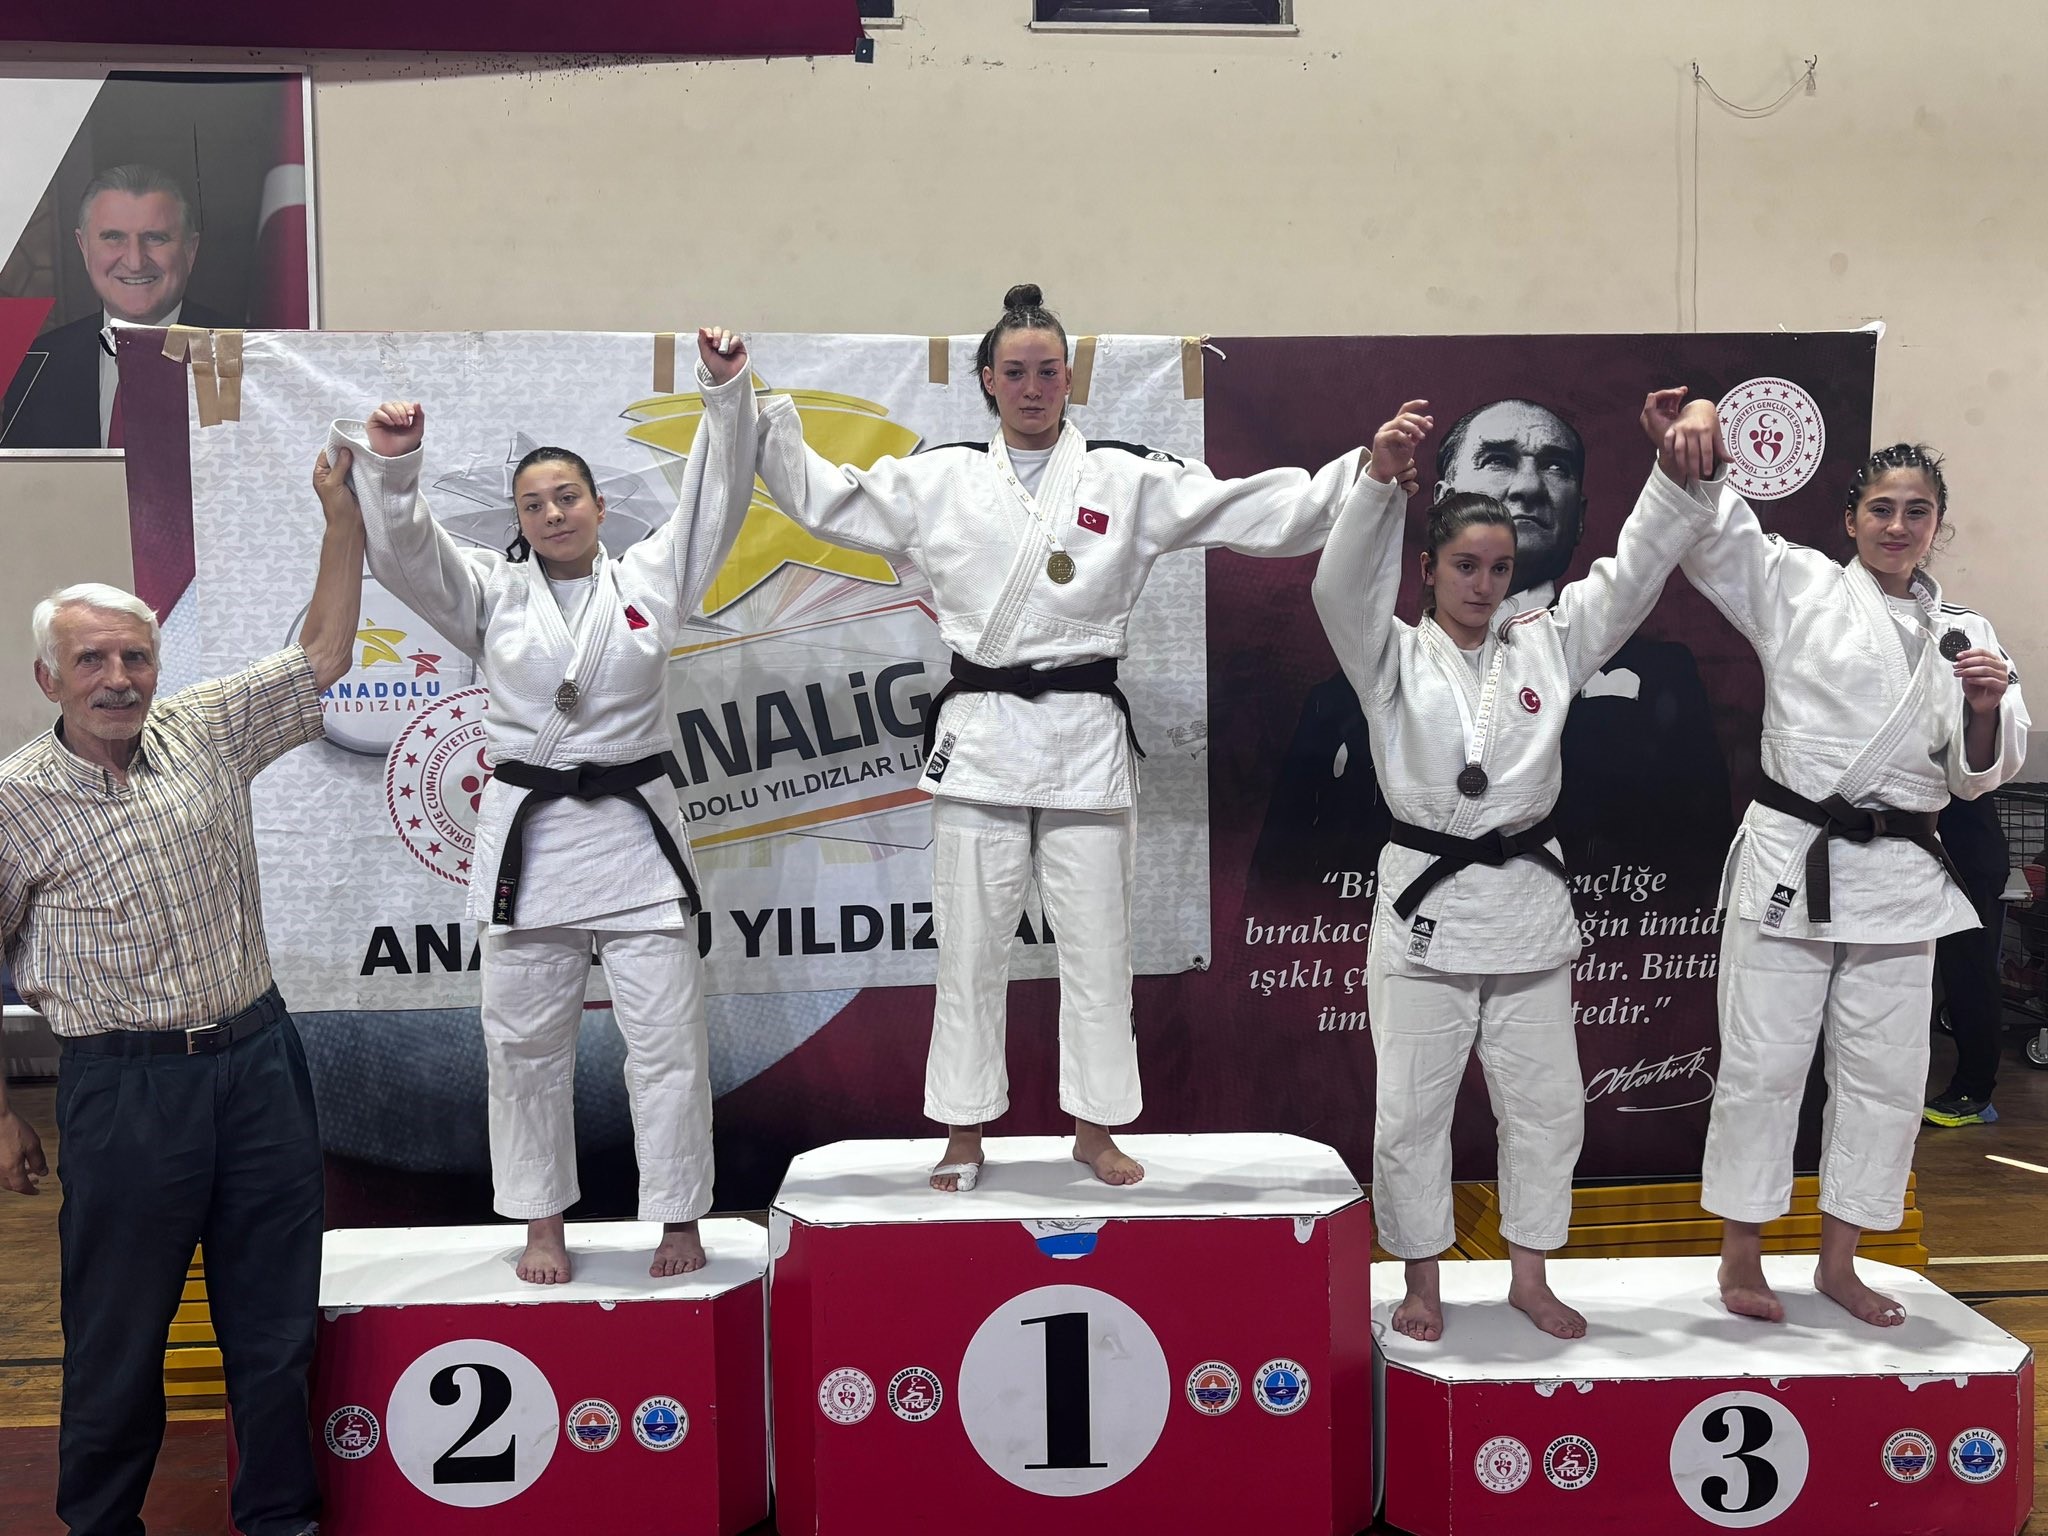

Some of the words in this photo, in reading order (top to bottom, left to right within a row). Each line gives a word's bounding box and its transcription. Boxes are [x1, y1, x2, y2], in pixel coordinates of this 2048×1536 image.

[1757, 401, 1787, 413] GENÇLİK
[1787, 410, 1796, 420] VE
[1731, 405, 1756, 452] CUMHURİYETİ
[1793, 420, 1802, 439] SPOR
[1775, 440, 1802, 474] BAKANLIĞI
[426, 729, 470, 809] CUMHURİYETİ
[679, 788, 758, 823] DOLU
[764, 756, 894, 802] YILDIZLAR
[900, 744, 929, 771] Lİ
[433, 811, 475, 850] ÜRKİYE
[1322, 871, 1376, 899] “Bi
[1573, 865, 1667, 902] nçliğe
[1245, 915, 1369, 945] bırakac
[1640, 908, 1727, 937] ümid
[1249, 959, 1333, 997] ışıklı
[1640, 953, 1717, 980] Bütü
[894, 1369, 918, 1383] KARATE
[1263, 1362, 1300, 1375] GEMLİK
[642, 1400, 678, 1412] GEMLİK
[1021, 1312, 1108, 1469] 1
[430, 1363, 516, 1484] 2
[1959, 1431, 1996, 1443] GEMLİK
[1549, 1437, 1574, 1451] KARATE
[1701, 1406, 1777, 1513] 3
